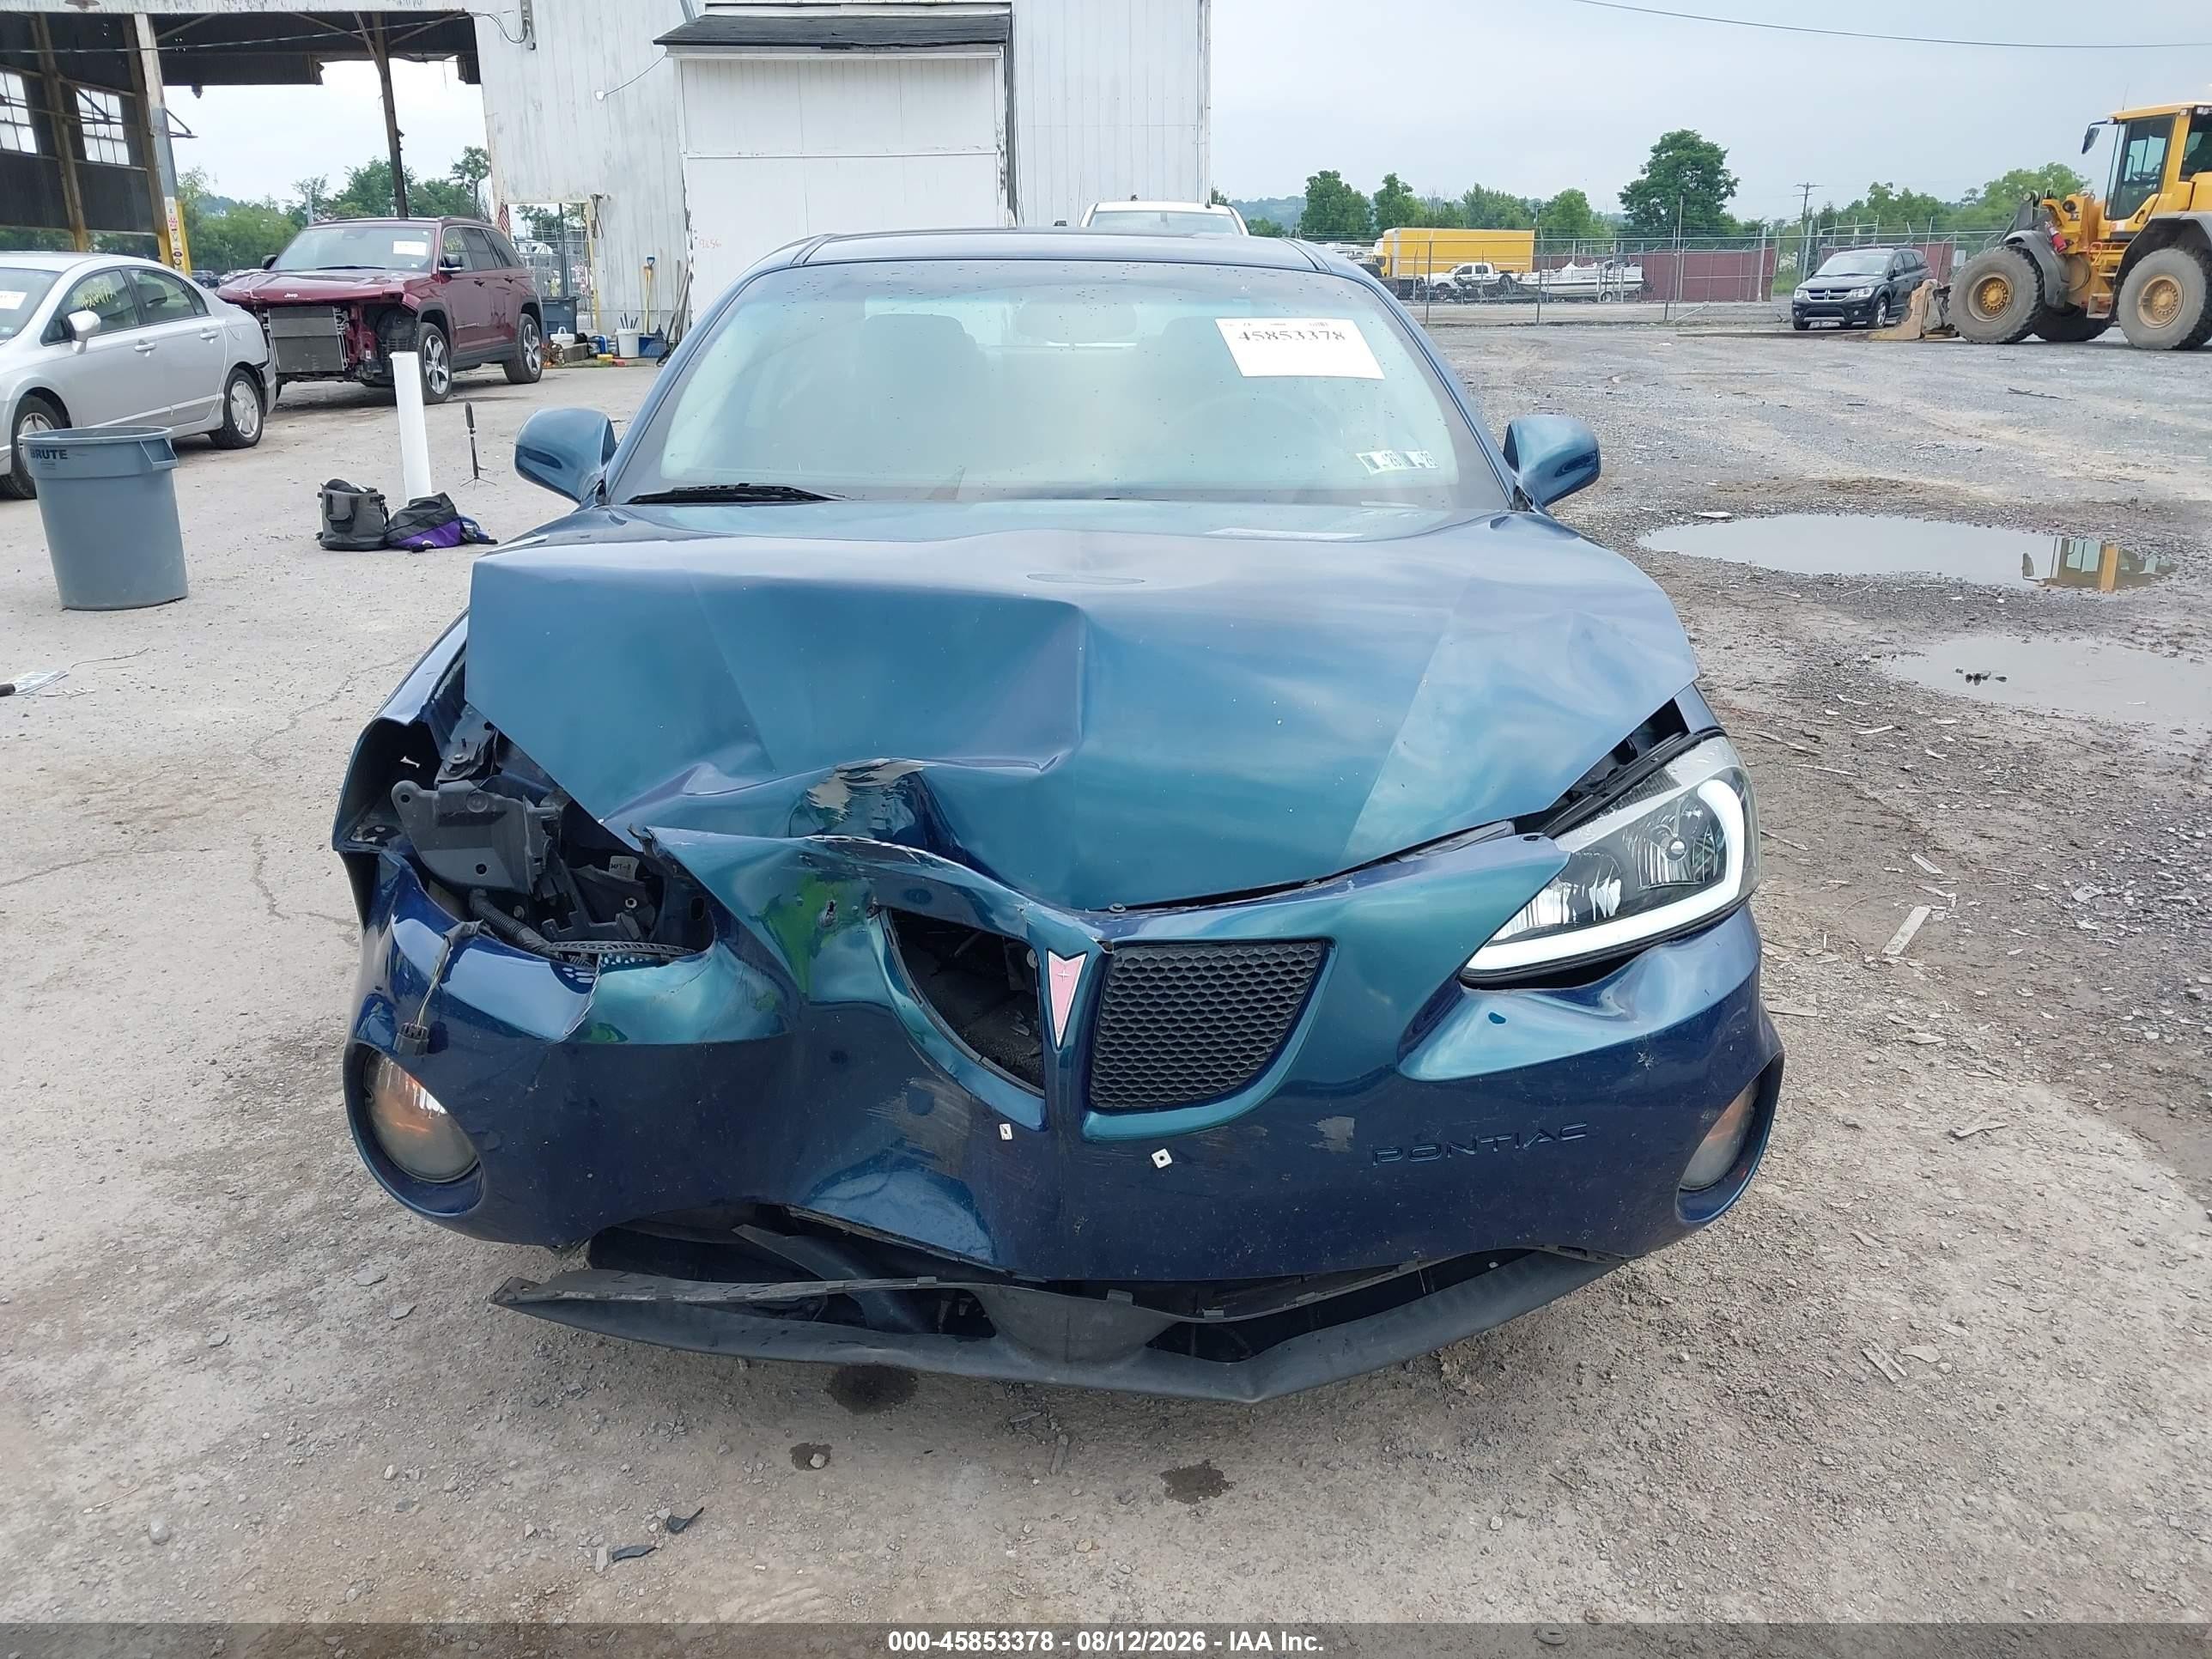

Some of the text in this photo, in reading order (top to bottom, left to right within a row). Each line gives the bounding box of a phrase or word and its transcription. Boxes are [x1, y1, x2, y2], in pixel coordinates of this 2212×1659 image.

[1238, 331, 1346, 342] 45853378
[29, 448, 69, 460] BRUTE
[1371, 1121, 1588, 1167] PONTIAC
